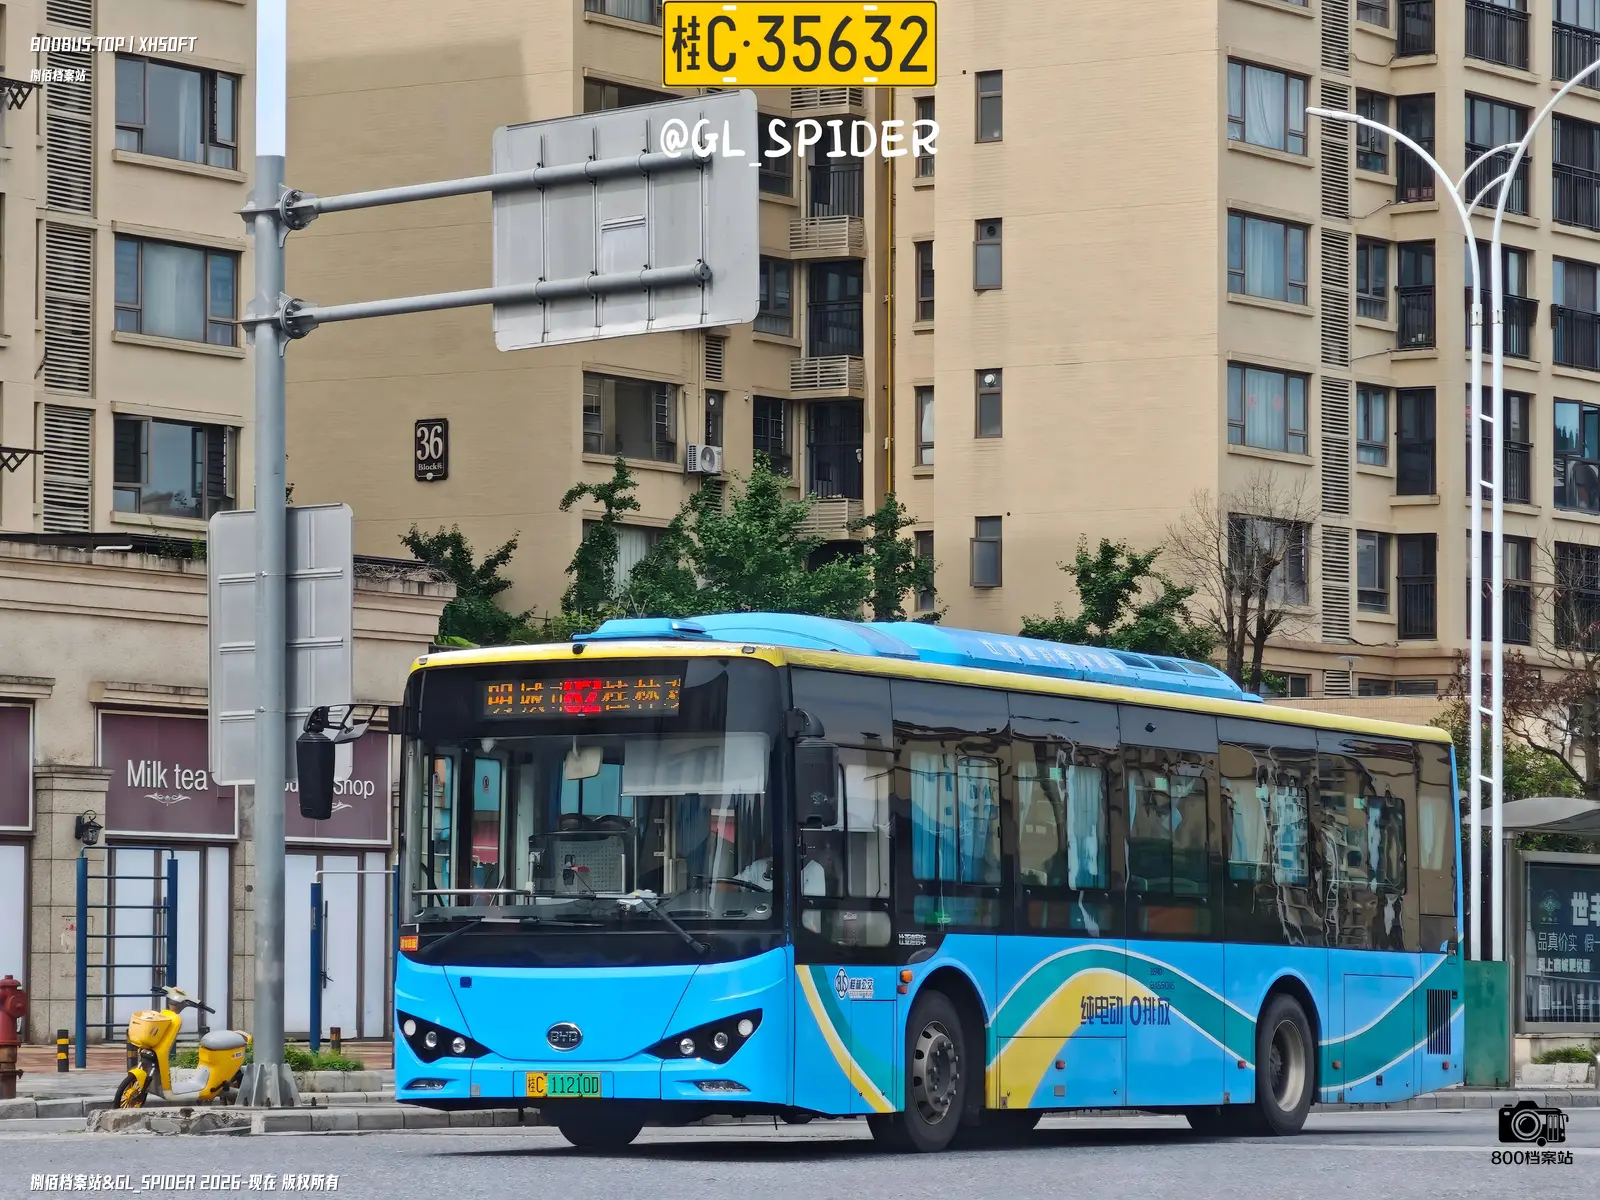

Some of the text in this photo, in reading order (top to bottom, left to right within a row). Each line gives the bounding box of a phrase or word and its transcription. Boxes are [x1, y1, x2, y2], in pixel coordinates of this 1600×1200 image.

[416, 425, 443, 461] 36
[127, 759, 208, 791] Milk tea
[1538, 932, 1578, 952] 品真价实
[1080, 996, 1123, 1025] 纯电动
[550, 1031, 578, 1042] BYD
